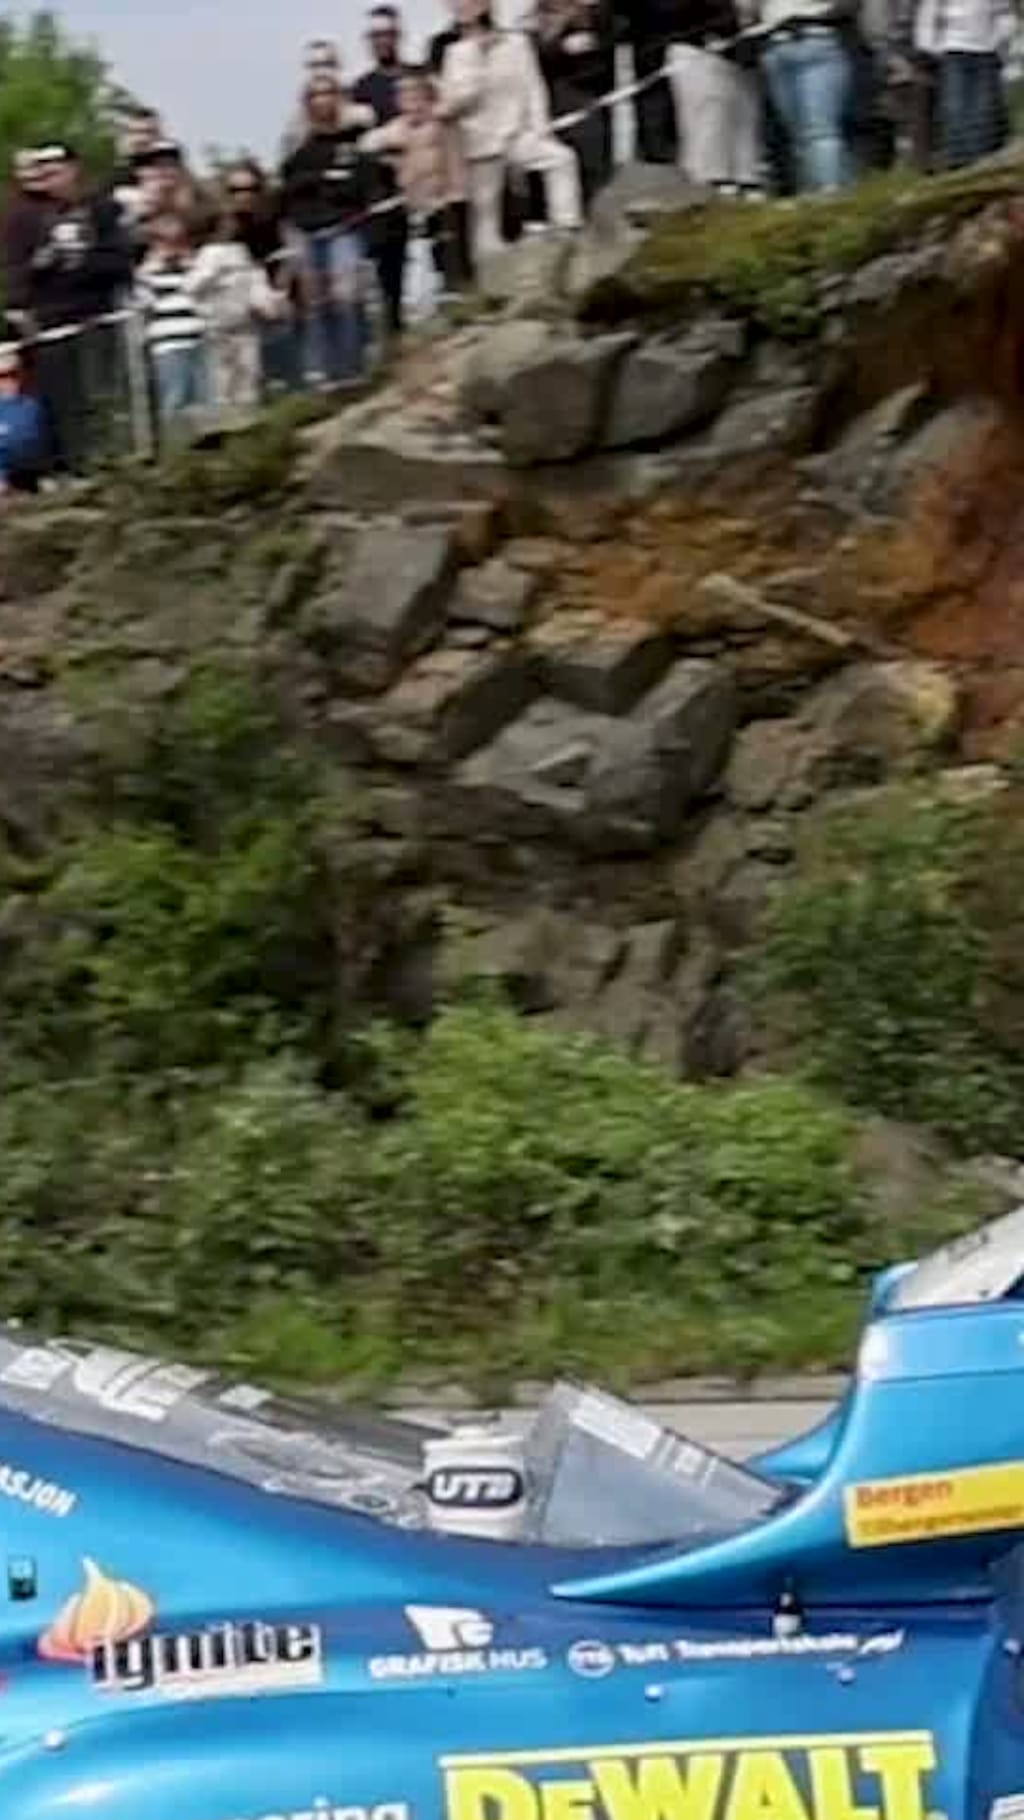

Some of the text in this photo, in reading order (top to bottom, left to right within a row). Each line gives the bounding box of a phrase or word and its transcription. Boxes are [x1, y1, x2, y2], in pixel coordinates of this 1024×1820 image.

[431, 1474, 516, 1501] UTB
[856, 1479, 953, 1509] Bergen
[489, 1648, 548, 1669] HUS
